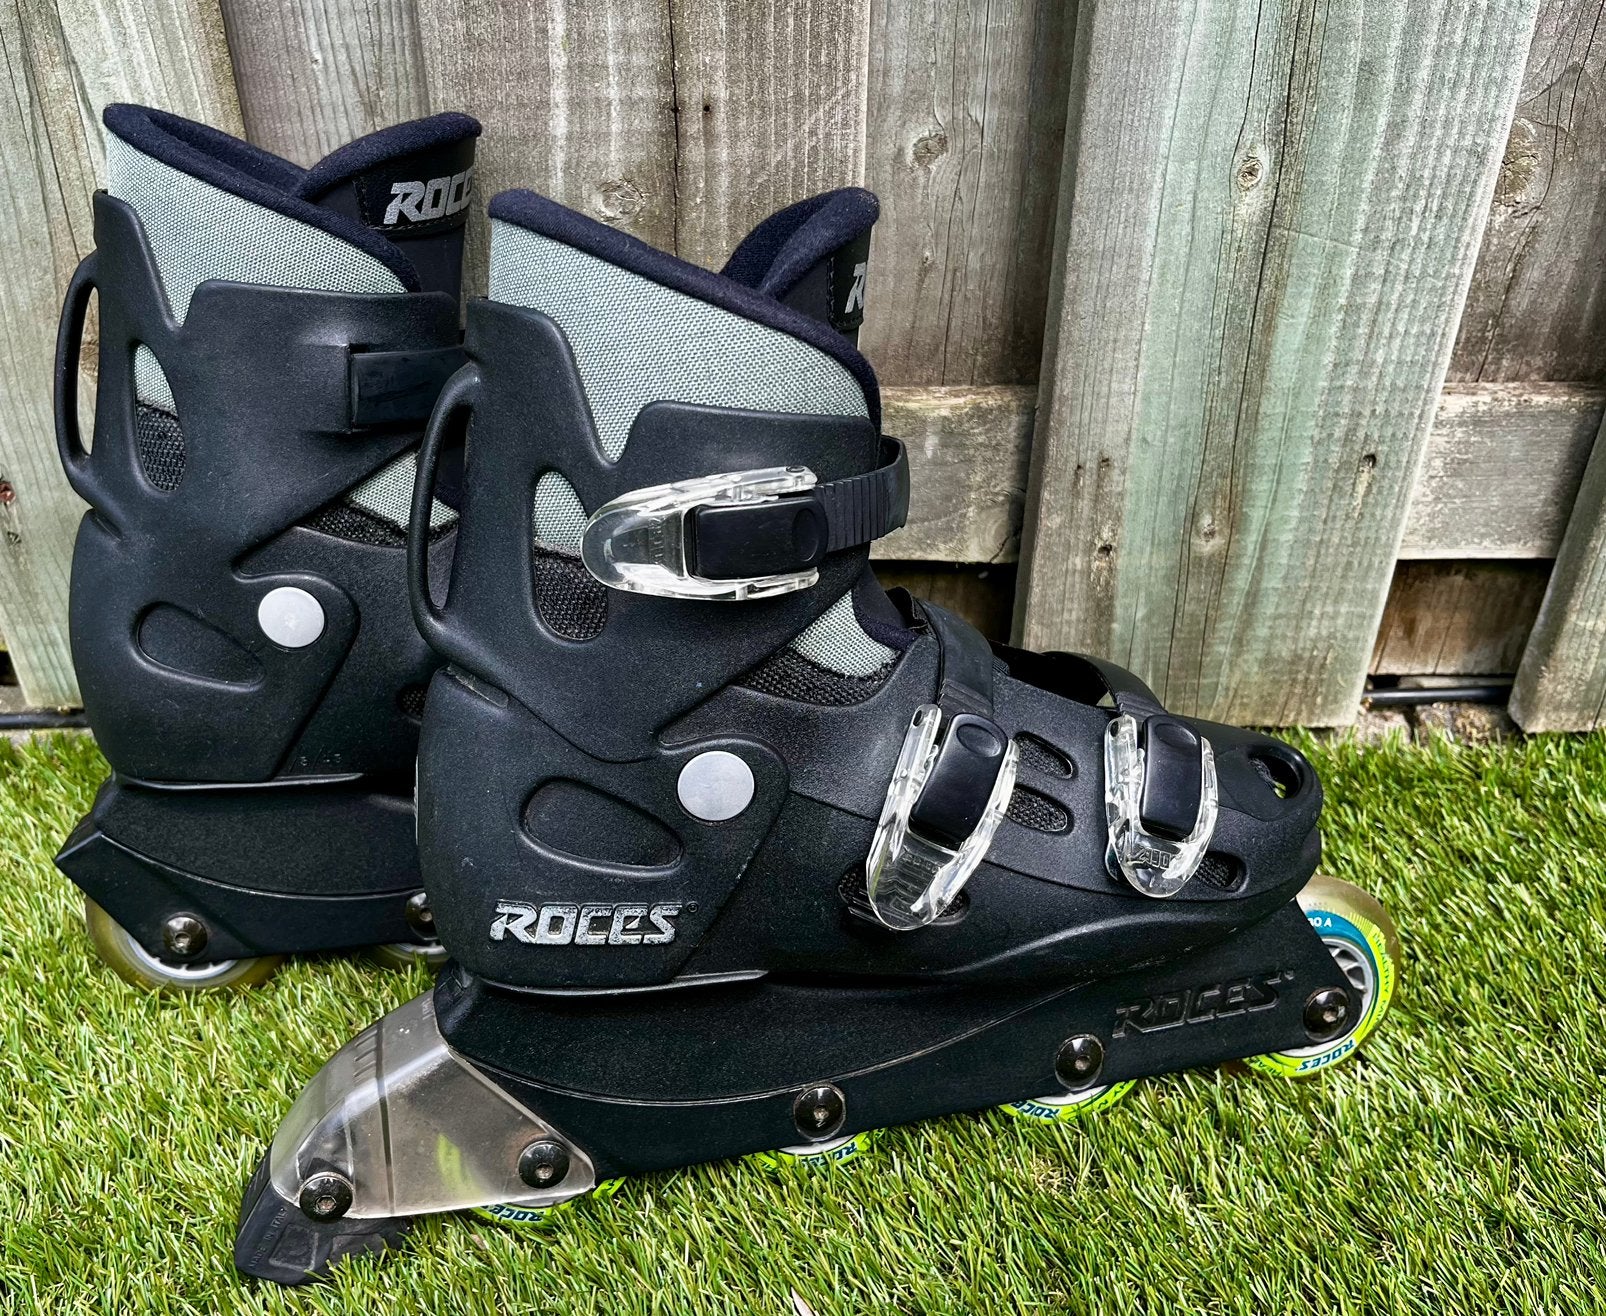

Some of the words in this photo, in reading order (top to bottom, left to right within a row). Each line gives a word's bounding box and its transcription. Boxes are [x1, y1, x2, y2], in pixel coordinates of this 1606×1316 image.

[490, 900, 683, 945] ROCES
[1323, 917, 1333, 927] A
[1111, 971, 1282, 1038] ROCES
[1298, 1039, 1355, 1072] ROCES
